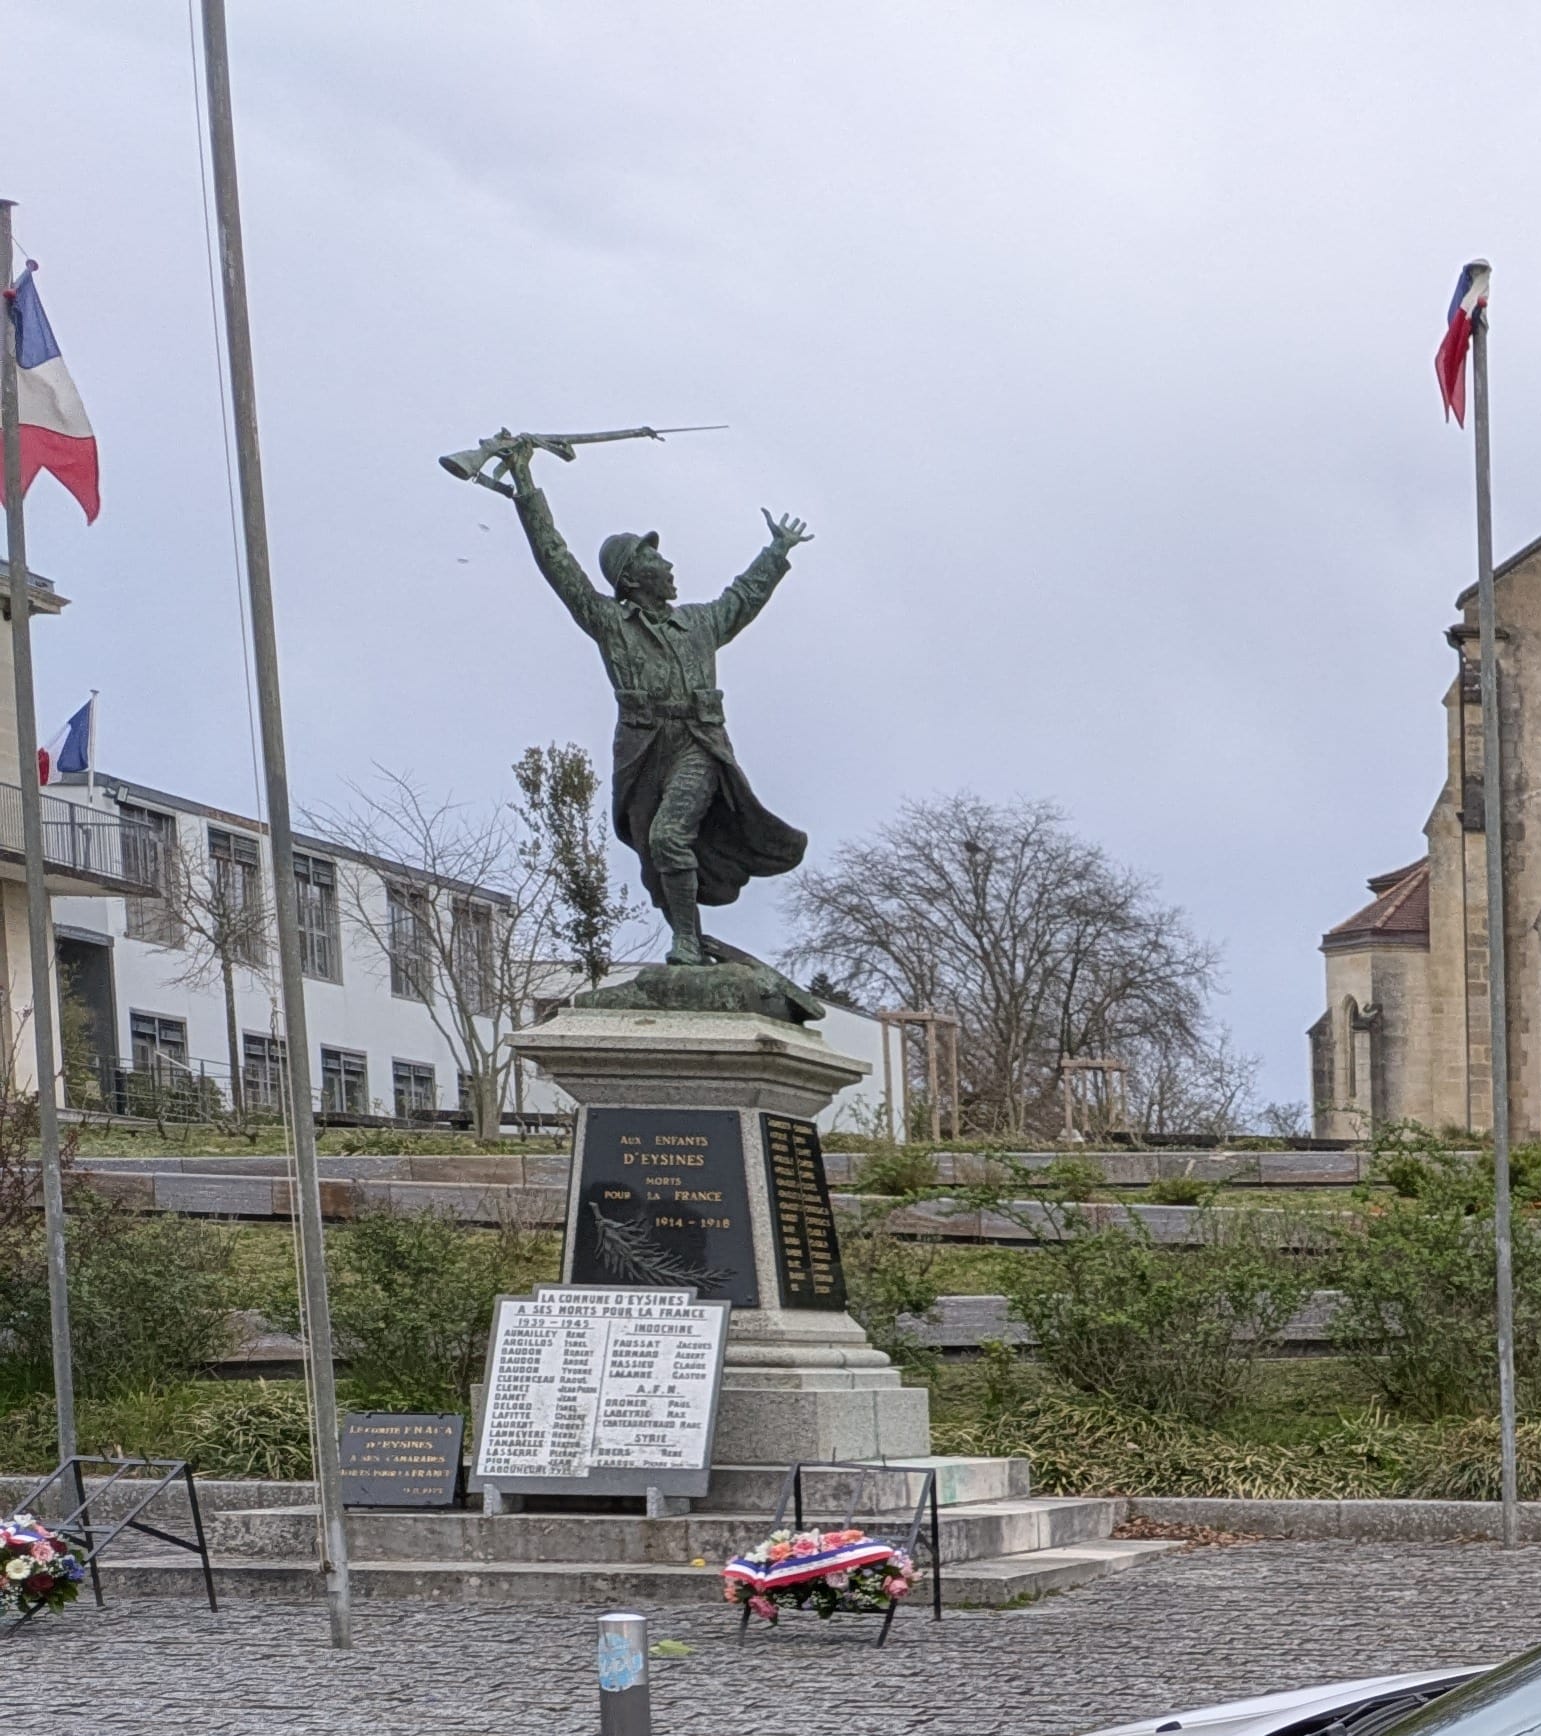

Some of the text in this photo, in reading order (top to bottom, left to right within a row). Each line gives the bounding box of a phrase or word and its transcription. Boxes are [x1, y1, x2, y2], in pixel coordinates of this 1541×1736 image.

[655, 1135, 709, 1146] ENFANTS
[623, 1151, 705, 1166] D'EYSINES
[645, 1176, 682, 1186] MORTS
[603, 1190, 722, 1202] POUR LA FRANCE
[655, 1217, 683, 1228] 1914
[700, 1218, 730, 1229] 1918
[541, 1294, 684, 1306] LA COMMUNE D'EYSINES
[517, 1305, 705, 1318] A SES MORTS POUR LA FRANCE
[518, 1318, 545, 1327] 1939
[561, 1319, 589, 1328] 1945
[634, 1323, 693, 1334] INDOCHINE
[613, 1339, 661, 1348] FAUSSAT
[612, 1349, 659, 1358] BERNARD
[497, 1375, 555, 1384] CLEMENCEAU
[609, 1370, 653, 1379] LALANNE
[492, 1411, 531, 1420] LAFITTE
[490, 1421, 534, 1429] LAURENT
[634, 1433, 667, 1443] SYRIE
